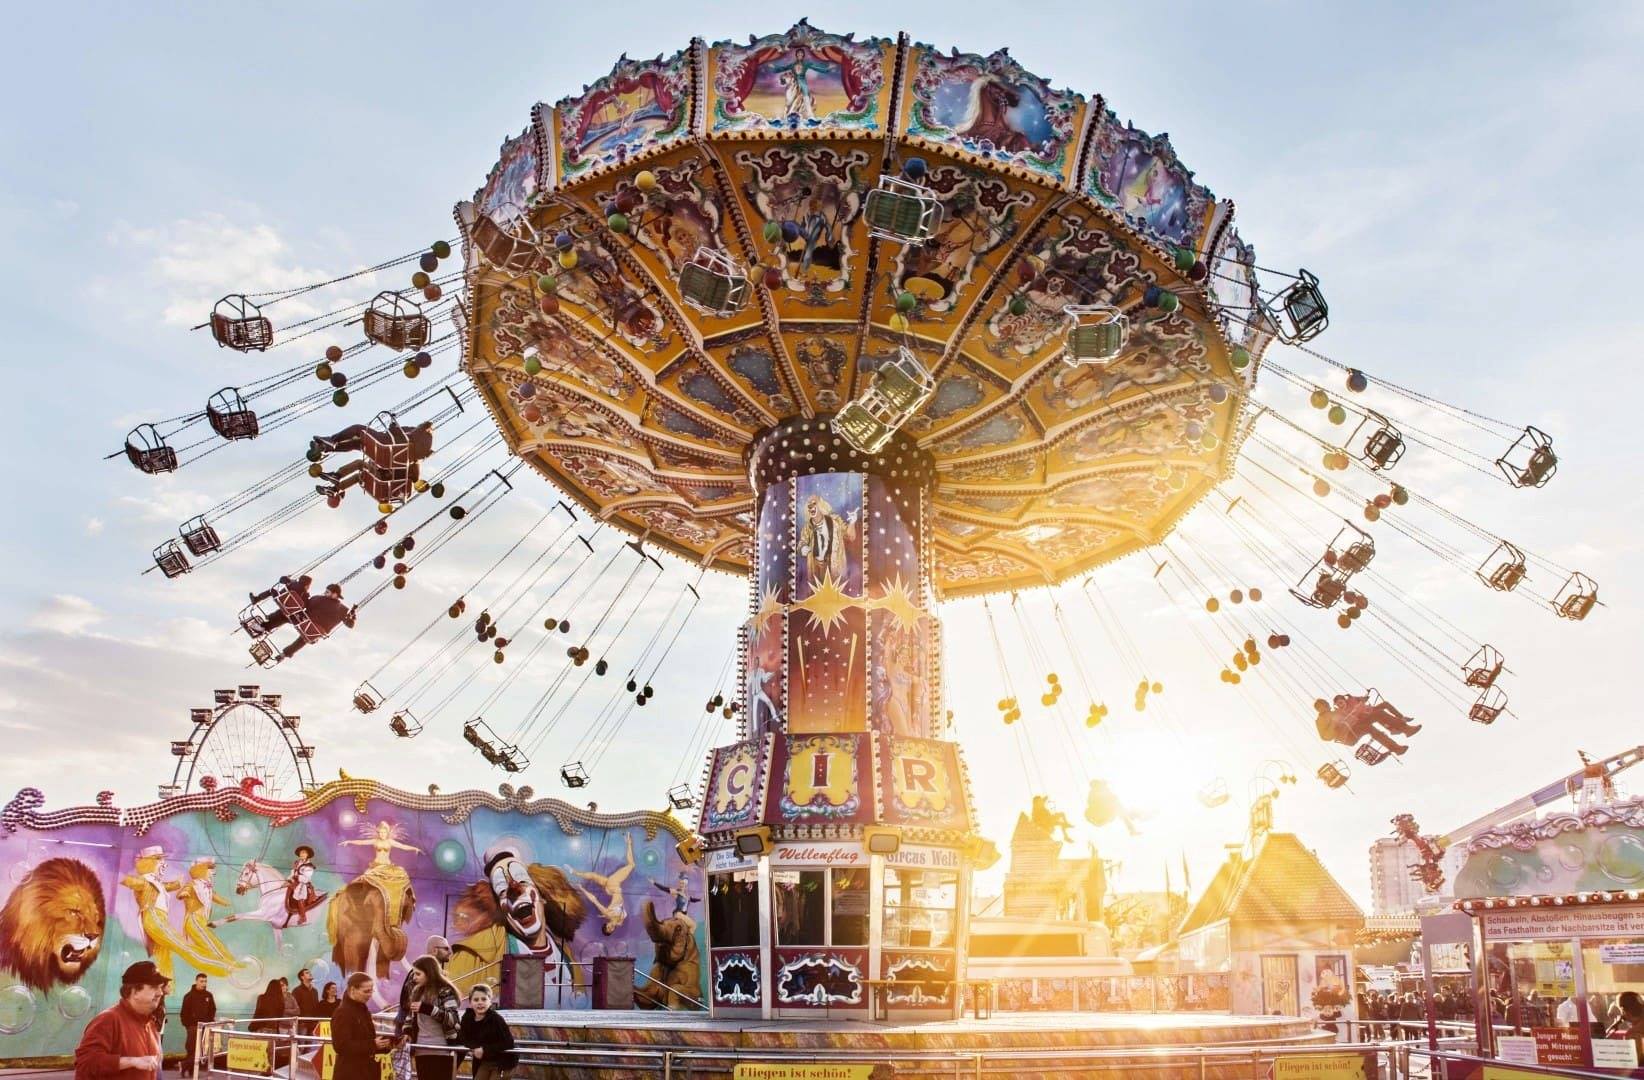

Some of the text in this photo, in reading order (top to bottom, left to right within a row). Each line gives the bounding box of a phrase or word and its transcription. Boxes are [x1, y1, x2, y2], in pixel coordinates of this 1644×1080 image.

[779, 847, 859, 864] Wellenflug
[886, 850, 958, 867] Circus Welt
[1487, 926, 1501, 935] das
[1503, 925, 1544, 934] Festhalten
[1546, 924, 1559, 933] der
[1561, 923, 1615, 932] Nachbarsitze
[1617, 922, 1629, 930] ist
[1311, 1061, 1322, 1070] ist
[740, 1067, 851, 1080] Fliegen ist schön!
